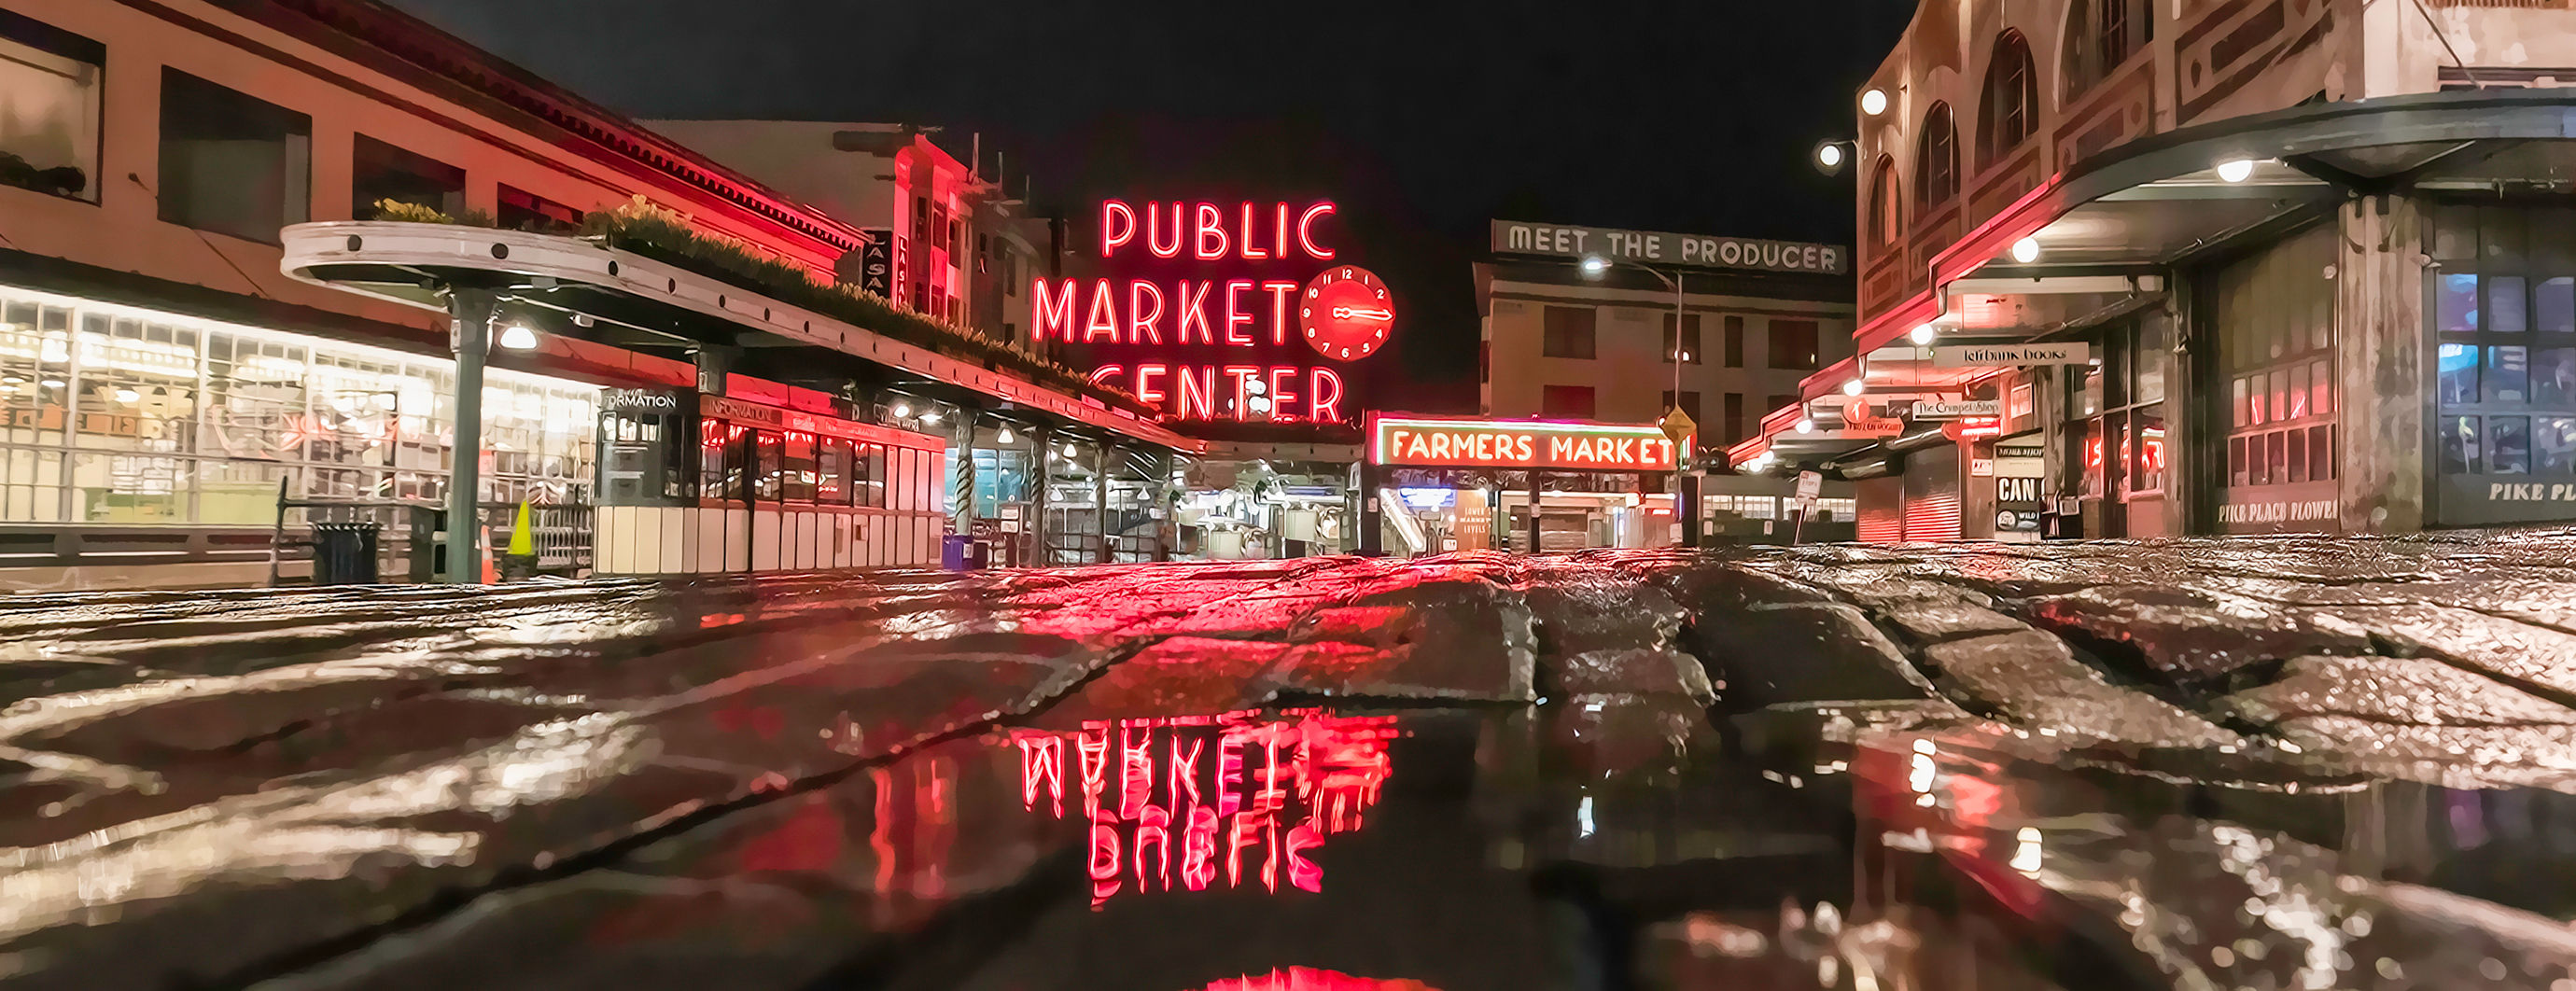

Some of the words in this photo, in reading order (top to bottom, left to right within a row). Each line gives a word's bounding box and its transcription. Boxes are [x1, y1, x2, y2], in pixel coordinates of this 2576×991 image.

[1102, 200, 1337, 260] PUBLIC
[1508, 225, 1589, 253] MEET
[1607, 232, 1660, 258] THE
[1681, 238, 1837, 271] PRODUCER
[1323, 273, 1332, 286] 11
[1342, 269, 1352, 280] 12
[1364, 274, 1369, 286] 1
[1309, 287, 1319, 299] 10
[1377, 288, 1385, 300] 2
[1031, 277, 1298, 345] MARKET
[1302, 307, 1311, 318] 9
[1308, 328, 1316, 338] 8
[1375, 328, 1383, 340] 4
[1323, 342, 1330, 352] 7
[1341, 348, 1350, 358] 6
[1363, 342, 1370, 353] 5
[1392, 430, 1533, 461] FARMERS
[1551, 436, 1673, 464] MARKET
[1998, 478, 2035, 501] CAN
[2488, 482, 2545, 501] PIKE
[2218, 505, 2247, 523] PIKE
[2247, 502, 2288, 523] PLACE
